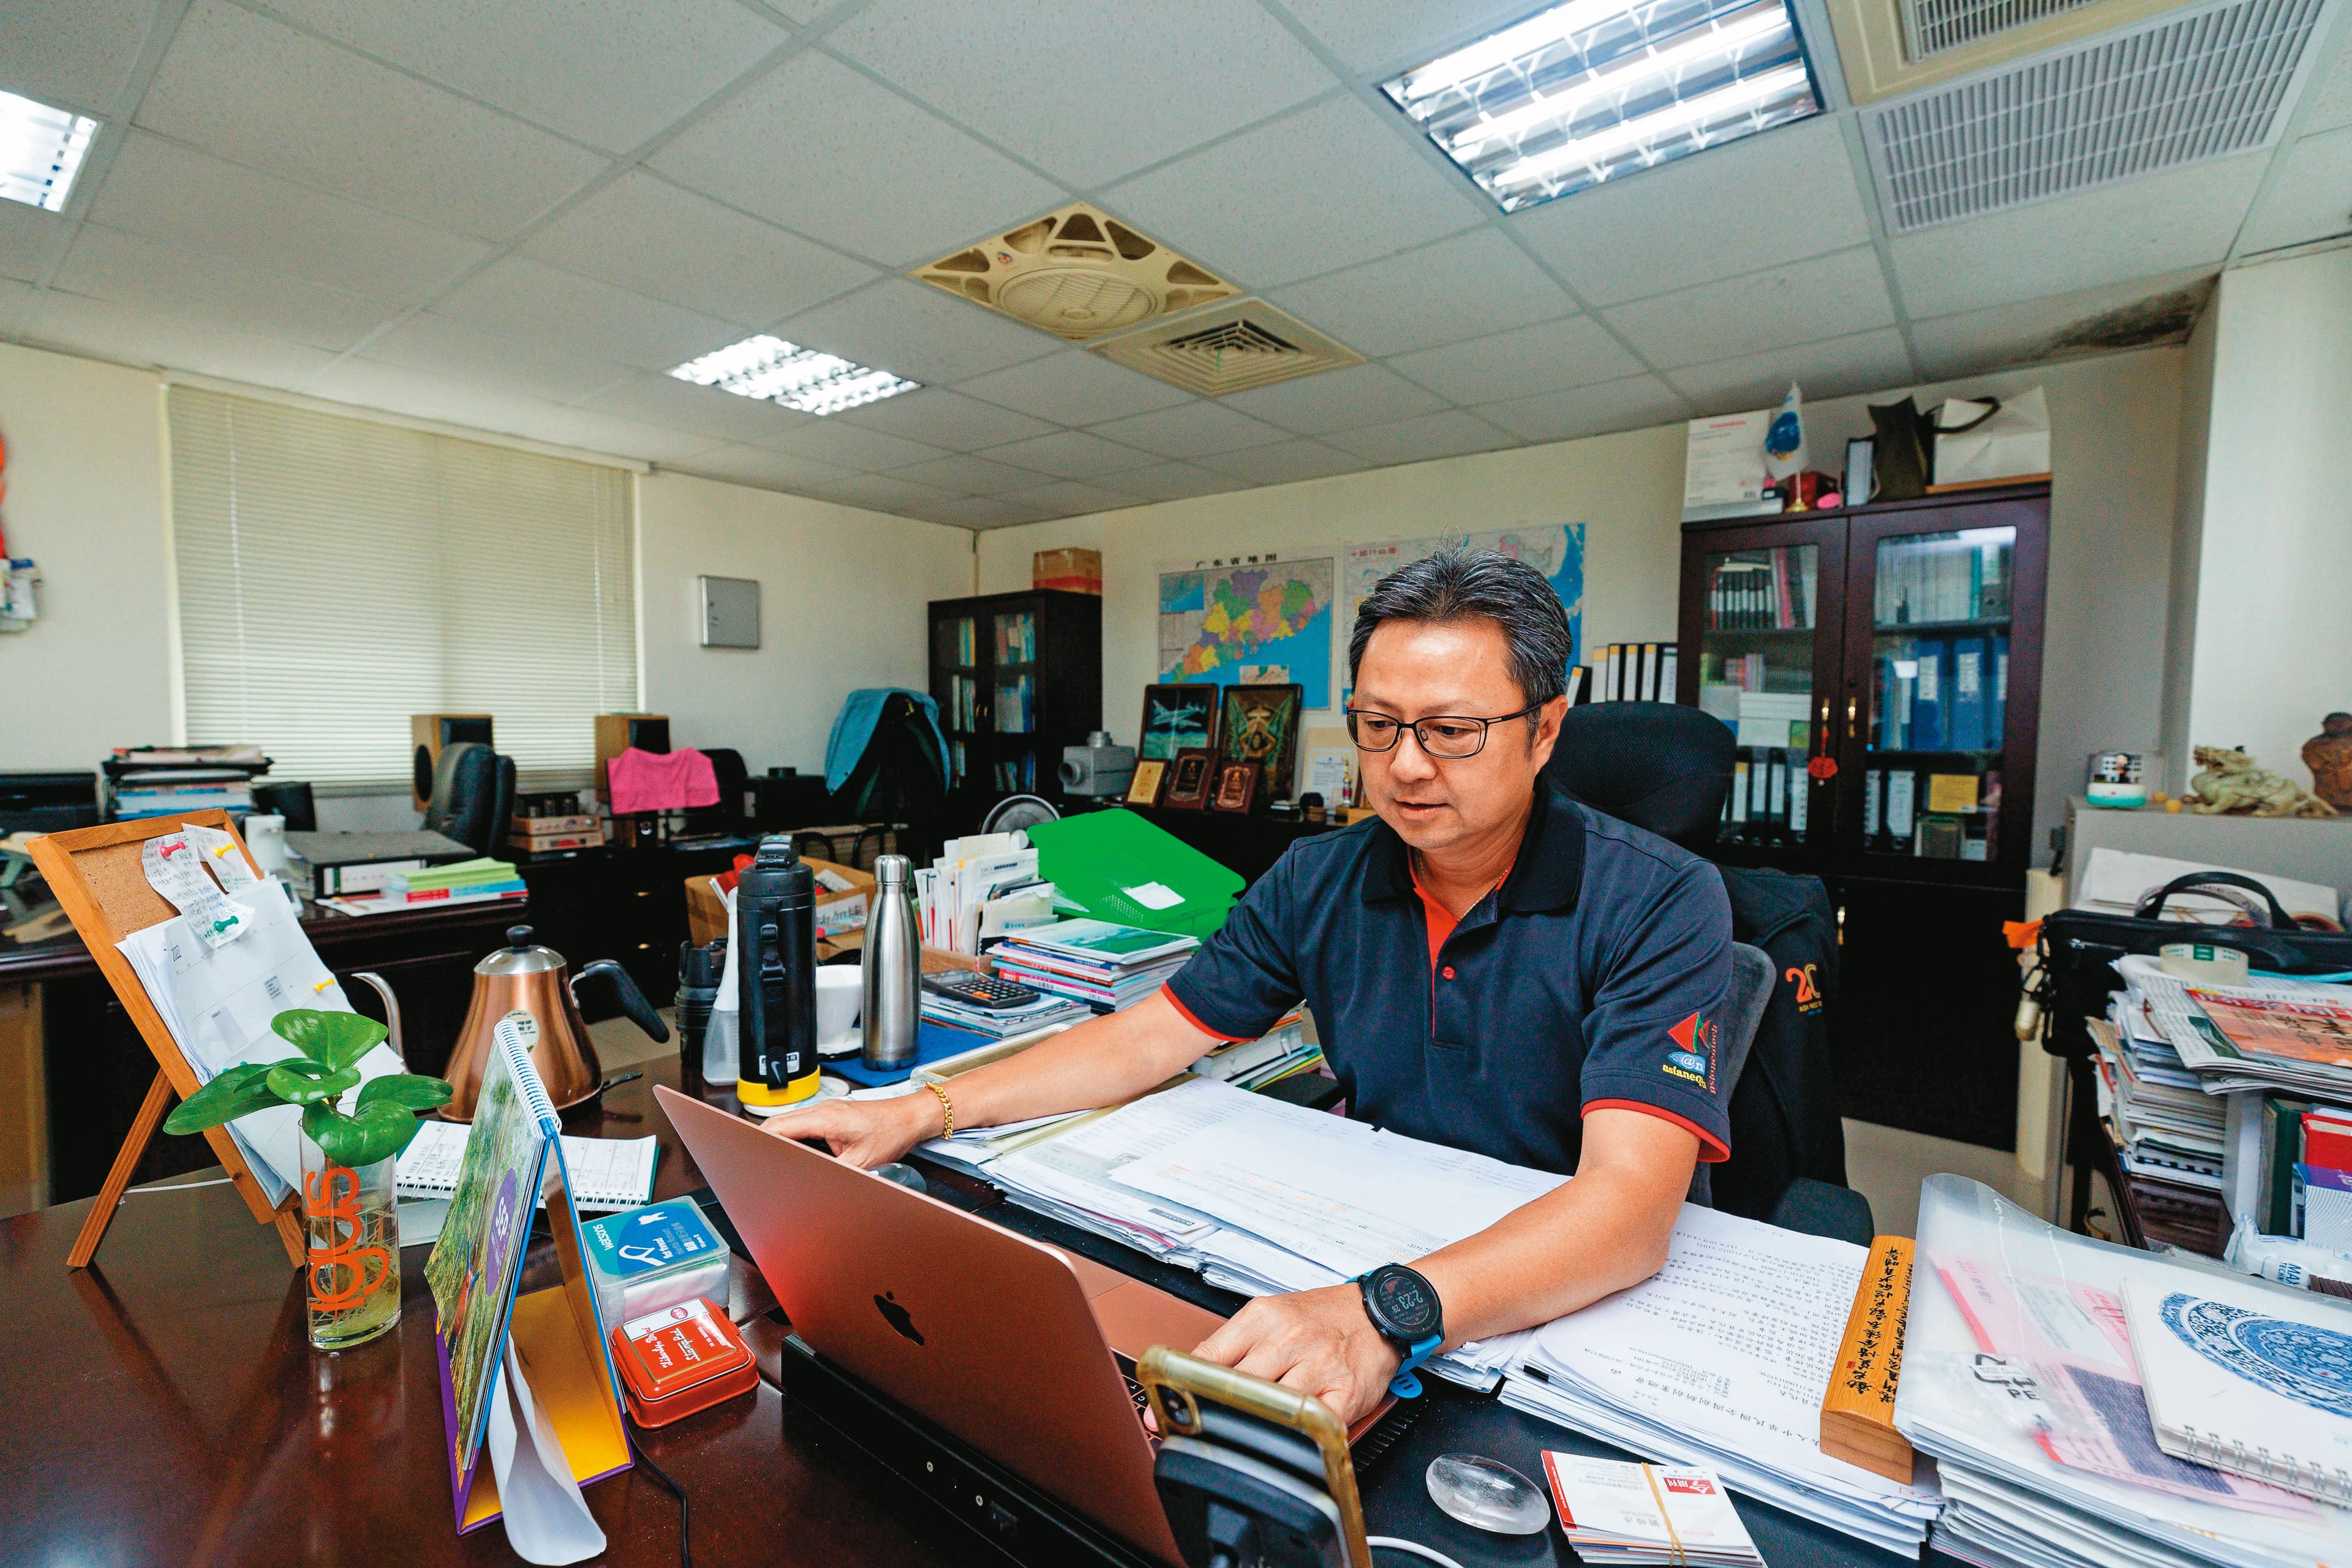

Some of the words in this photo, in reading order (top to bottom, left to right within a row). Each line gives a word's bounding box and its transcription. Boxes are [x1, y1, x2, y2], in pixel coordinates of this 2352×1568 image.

[304, 1166, 390, 1311] igus
[593, 1224, 614, 1250] watsons
[669, 1327, 687, 1341] Pad
[678, 1339, 701, 1362] Stamp
[2008, 1389, 2041, 1401] PE
[1666, 1478, 1711, 1494] 今周刊
